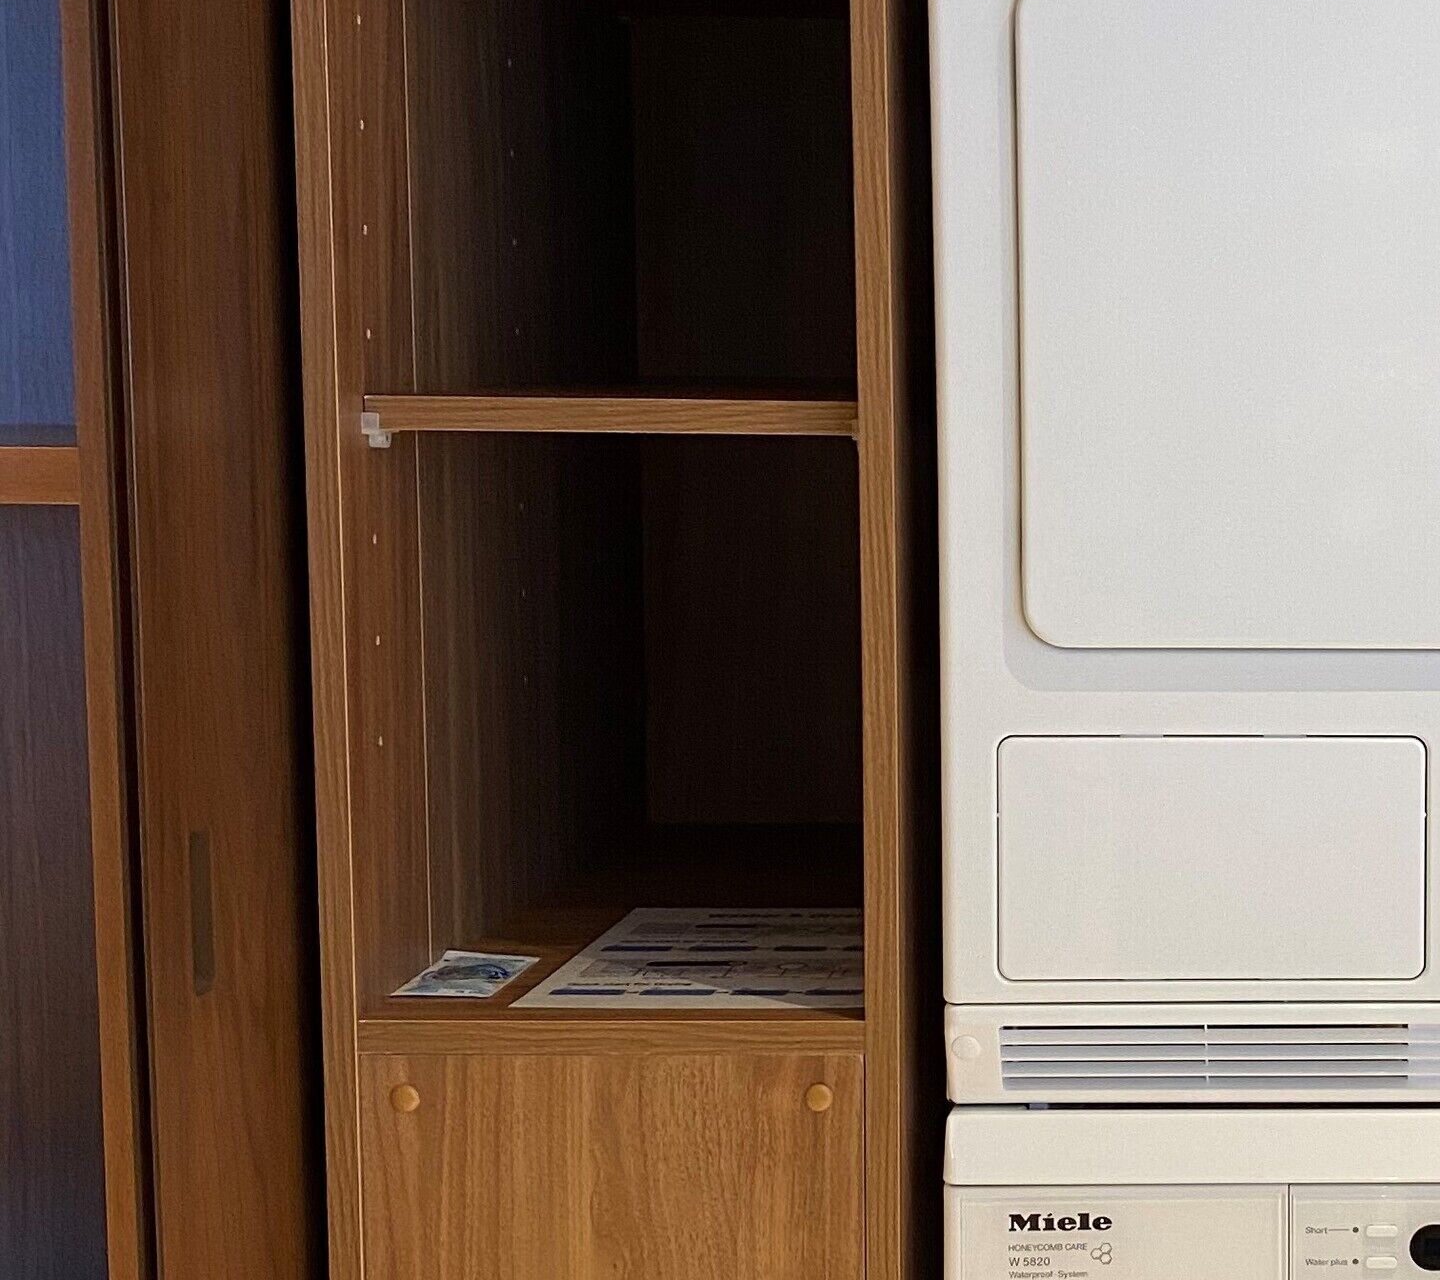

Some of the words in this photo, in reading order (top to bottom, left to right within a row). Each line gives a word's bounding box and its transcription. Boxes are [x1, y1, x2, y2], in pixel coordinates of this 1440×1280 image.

[1008, 1212, 1113, 1232] Miele
[1305, 1226, 1328, 1234] Short
[1008, 1243, 1063, 1252] HONEYCOMB
[1064, 1243, 1088, 1251] CARE
[1008, 1257, 1021, 1267] W
[1022, 1256, 1051, 1267] 5820
